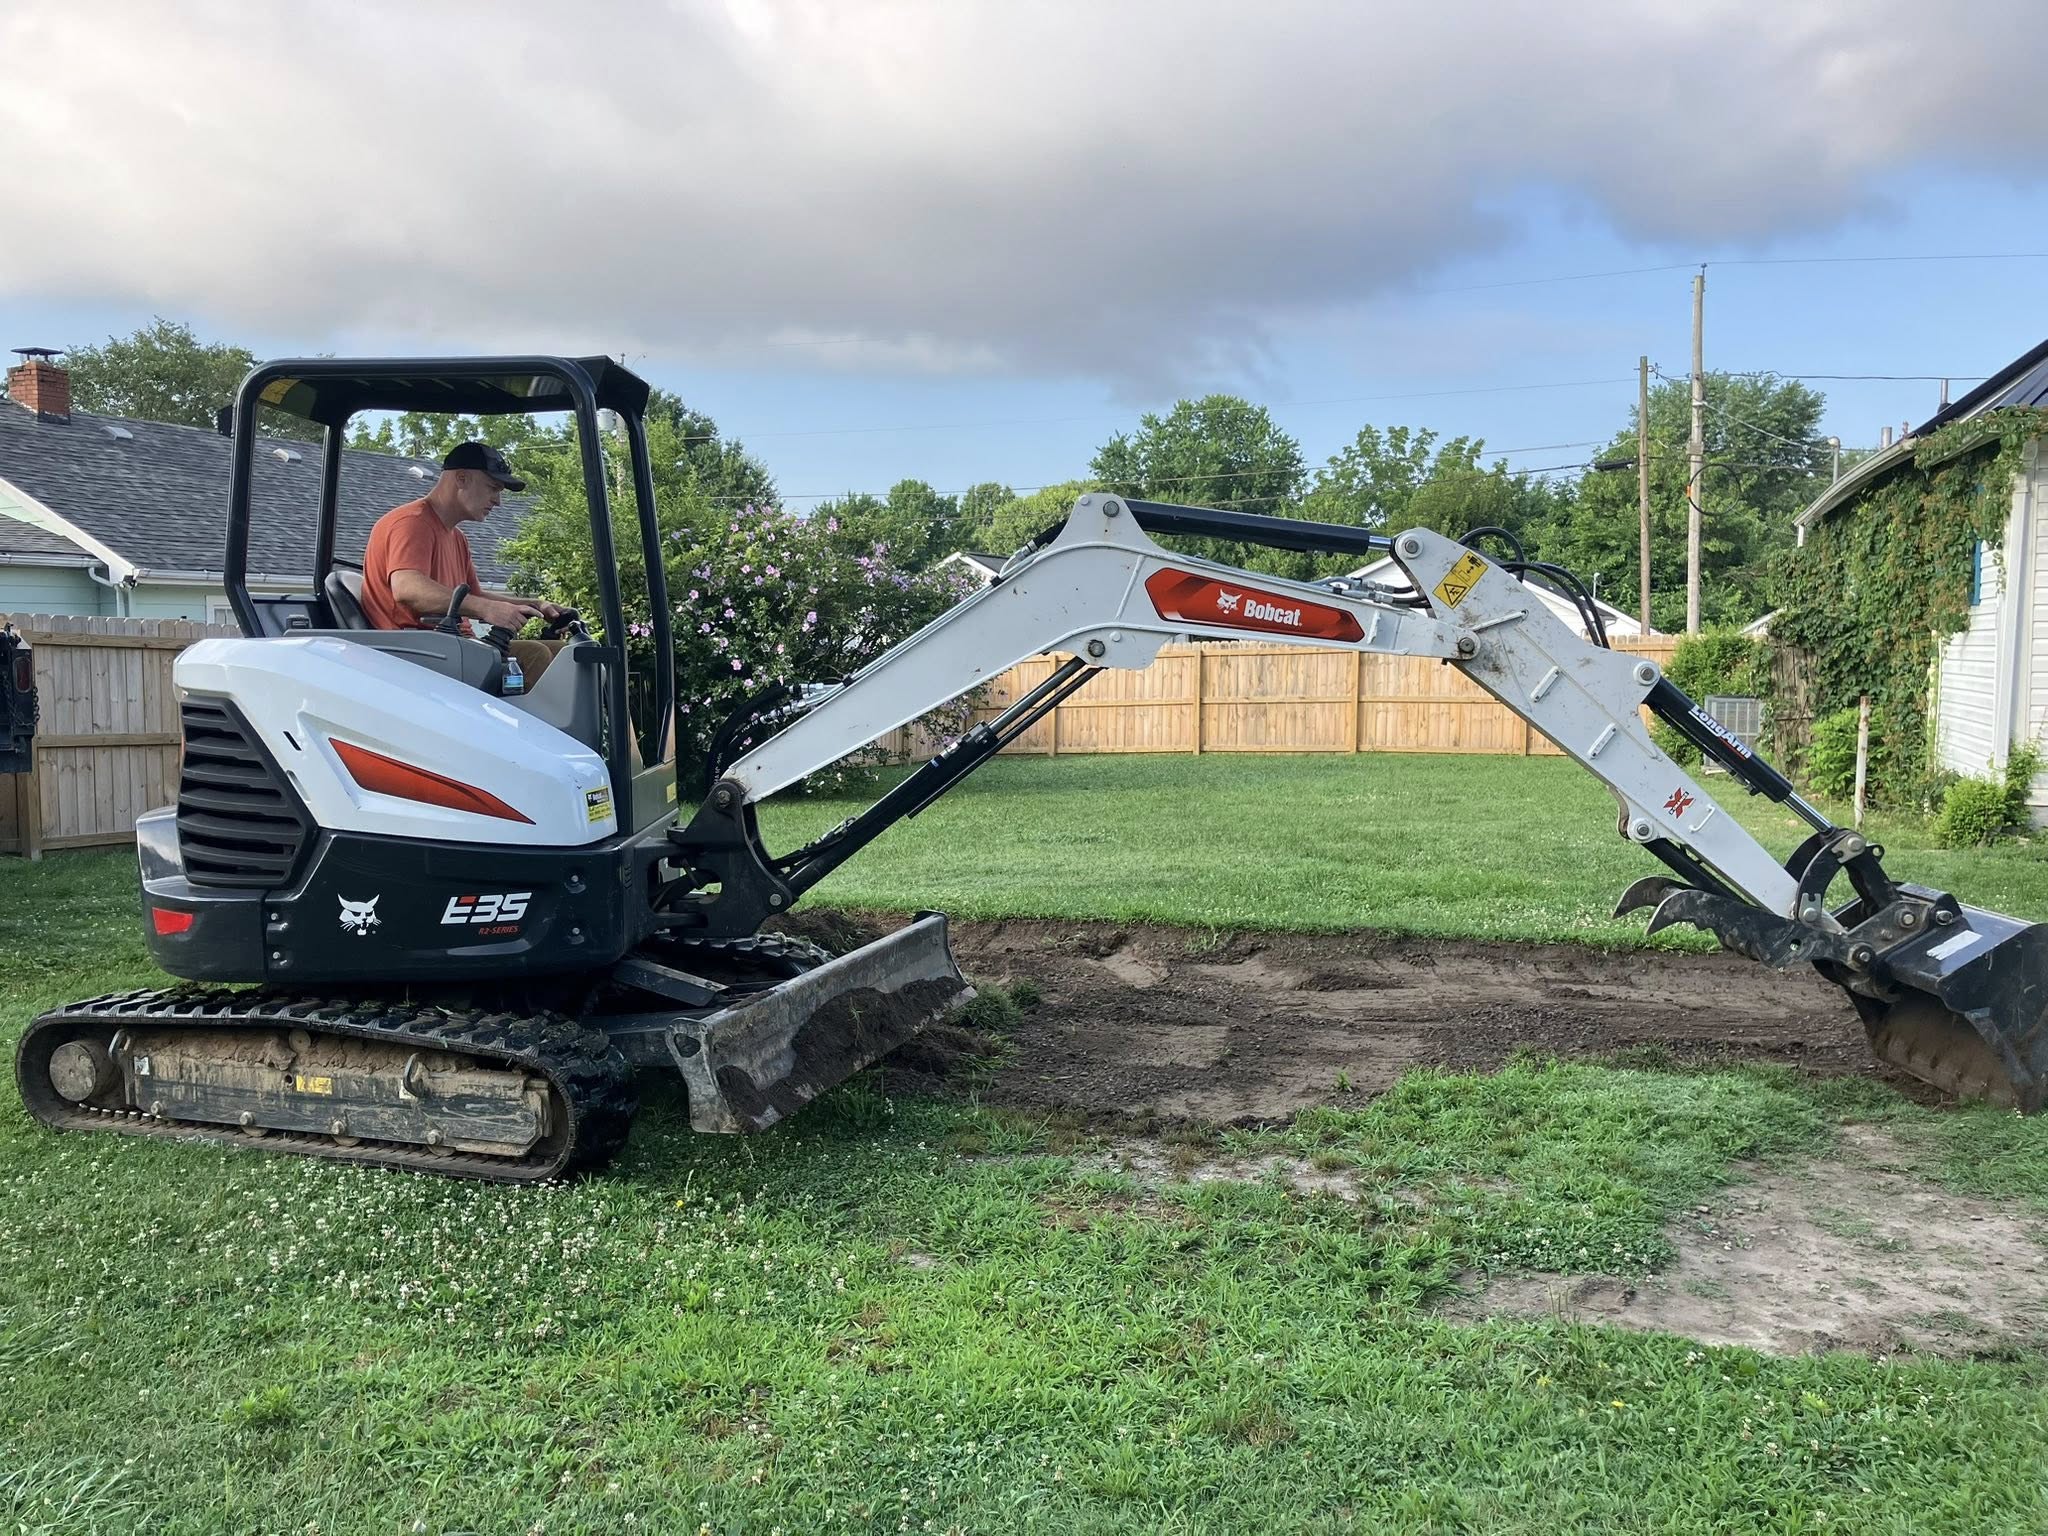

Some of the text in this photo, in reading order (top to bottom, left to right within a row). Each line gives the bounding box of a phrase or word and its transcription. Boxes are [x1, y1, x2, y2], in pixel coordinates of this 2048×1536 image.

[1243, 599, 1301, 627] Bobcat
[440, 892, 533, 925] E35
[478, 925, 519, 935] R2-SERIES
